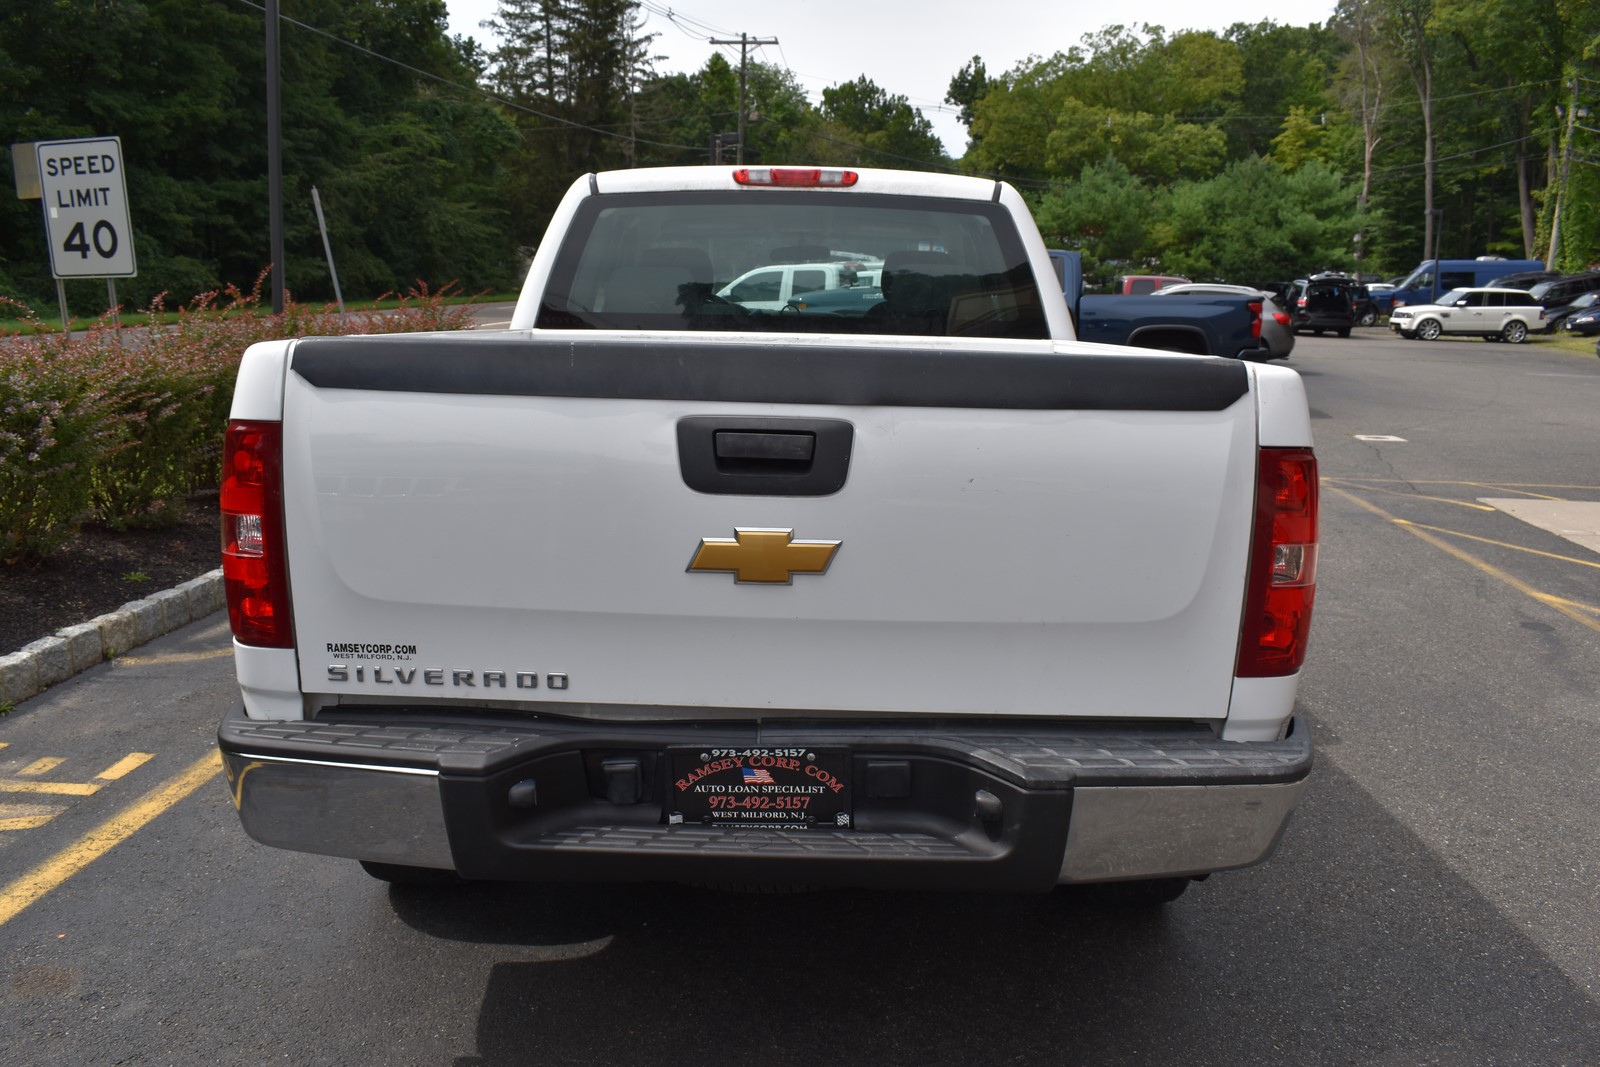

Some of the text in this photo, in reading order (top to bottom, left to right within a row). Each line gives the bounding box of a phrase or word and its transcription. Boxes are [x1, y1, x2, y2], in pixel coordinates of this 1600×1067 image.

[47, 155, 115, 176] SPEED
[57, 187, 110, 208] LIMIT
[63, 219, 118, 259] 40
[327, 643, 417, 655] RAMSEYCORP.COM
[357, 653, 396, 661] MILFORD,
[327, 664, 569, 690] SILVERADO
[711, 749, 806, 757] 973-492-5157
[675, 756, 845, 793] RAMSEY CORP. COM
[694, 785, 826, 794] AUTO LOAN SPECIALIST
[708, 795, 811, 809] 973-492-5157
[741, 811, 789, 819] MILFORD,
[791, 811, 807, 819] N.J.
